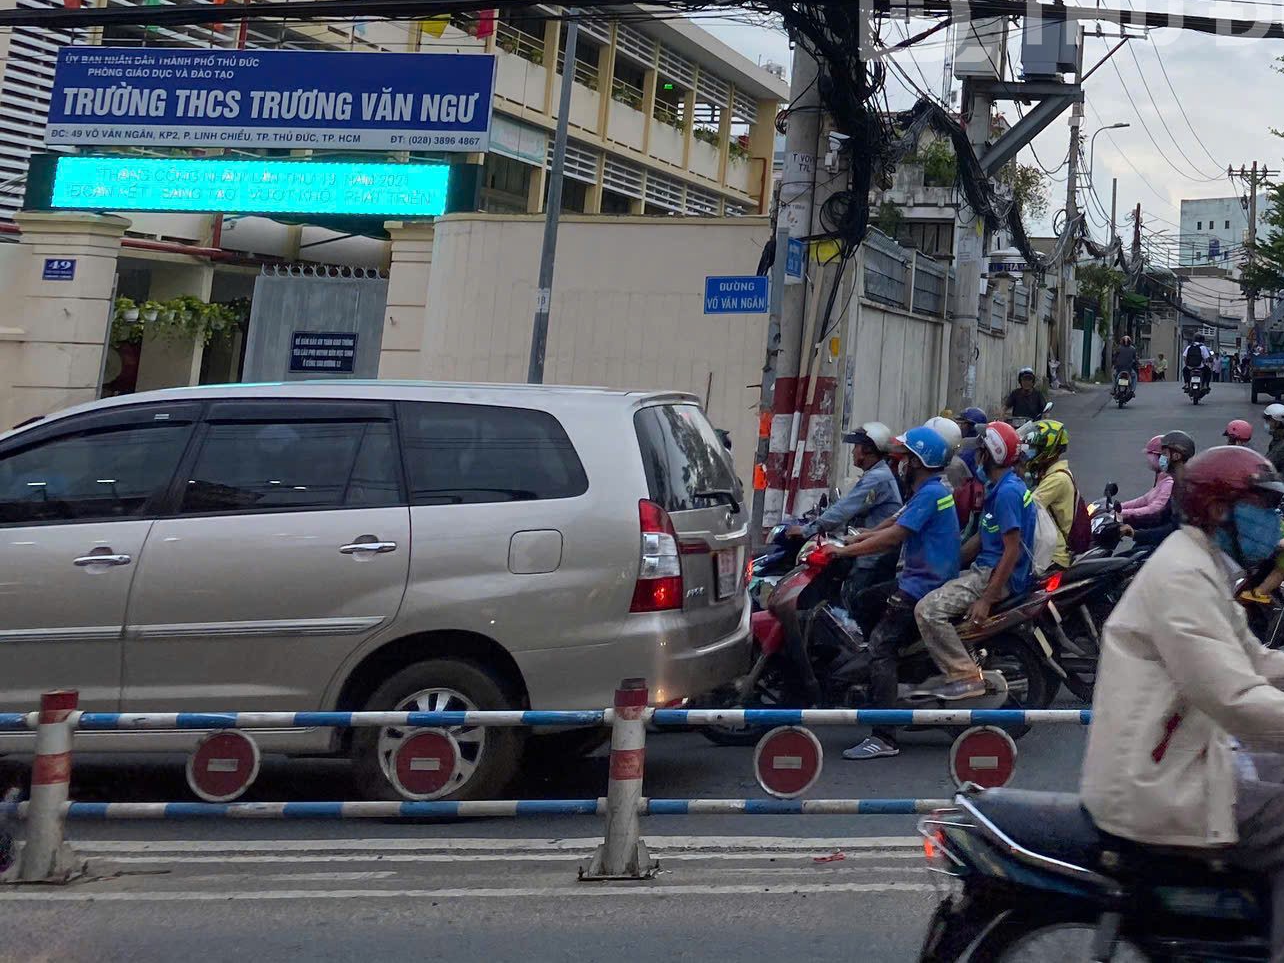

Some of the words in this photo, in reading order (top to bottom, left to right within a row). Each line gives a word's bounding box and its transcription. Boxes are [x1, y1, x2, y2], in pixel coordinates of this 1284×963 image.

[193, 54, 215, 67] PHỐ
[217, 55, 238, 68] THỦ
[238, 56, 260, 68] ĐỨC
[88, 67, 123, 77] PHÒNG
[125, 67, 149, 78] GIÁO
[151, 69, 173, 80] DỤC
[175, 68, 189, 79] VÀ
[191, 68, 213, 79] ĐÀO
[214, 70, 234, 81] TẠO
[63, 82, 167, 117] TRƯỜNG
[175, 89, 242, 119] THCS
[249, 89, 353, 121] TRƯƠNG
[361, 87, 414, 121] VĂN
[420, 92, 480, 124] NGƯ
[51, 129, 69, 138] ĐC:
[71, 129, 83, 138] 49
[86, 127, 99, 138] VÕ
[101, 128, 121, 139] VĂN
[124, 128, 155, 141] NGÂN,
[159, 131, 180, 141] KP2,
[183, 132, 194, 140] P.
[196, 132, 218, 141] LINH
[256, 133, 270, 142] TP.
[274, 130, 294, 143] THỦ
[295, 132, 319, 144] ĐỨC,
[322, 134, 336, 143] TP.
[338, 134, 361, 143] HCM
[390, 135, 405, 144] ĐT:
[408, 135, 432, 146] (028)
[433, 136, 456, 145] 3896
[457, 136, 480, 146] 4867
[48, 261, 71, 270] 49
[720, 280, 755, 291] ĐƯỜNG
[721, 296, 738, 309] VĂN
[741, 295, 765, 309] NGÂN
